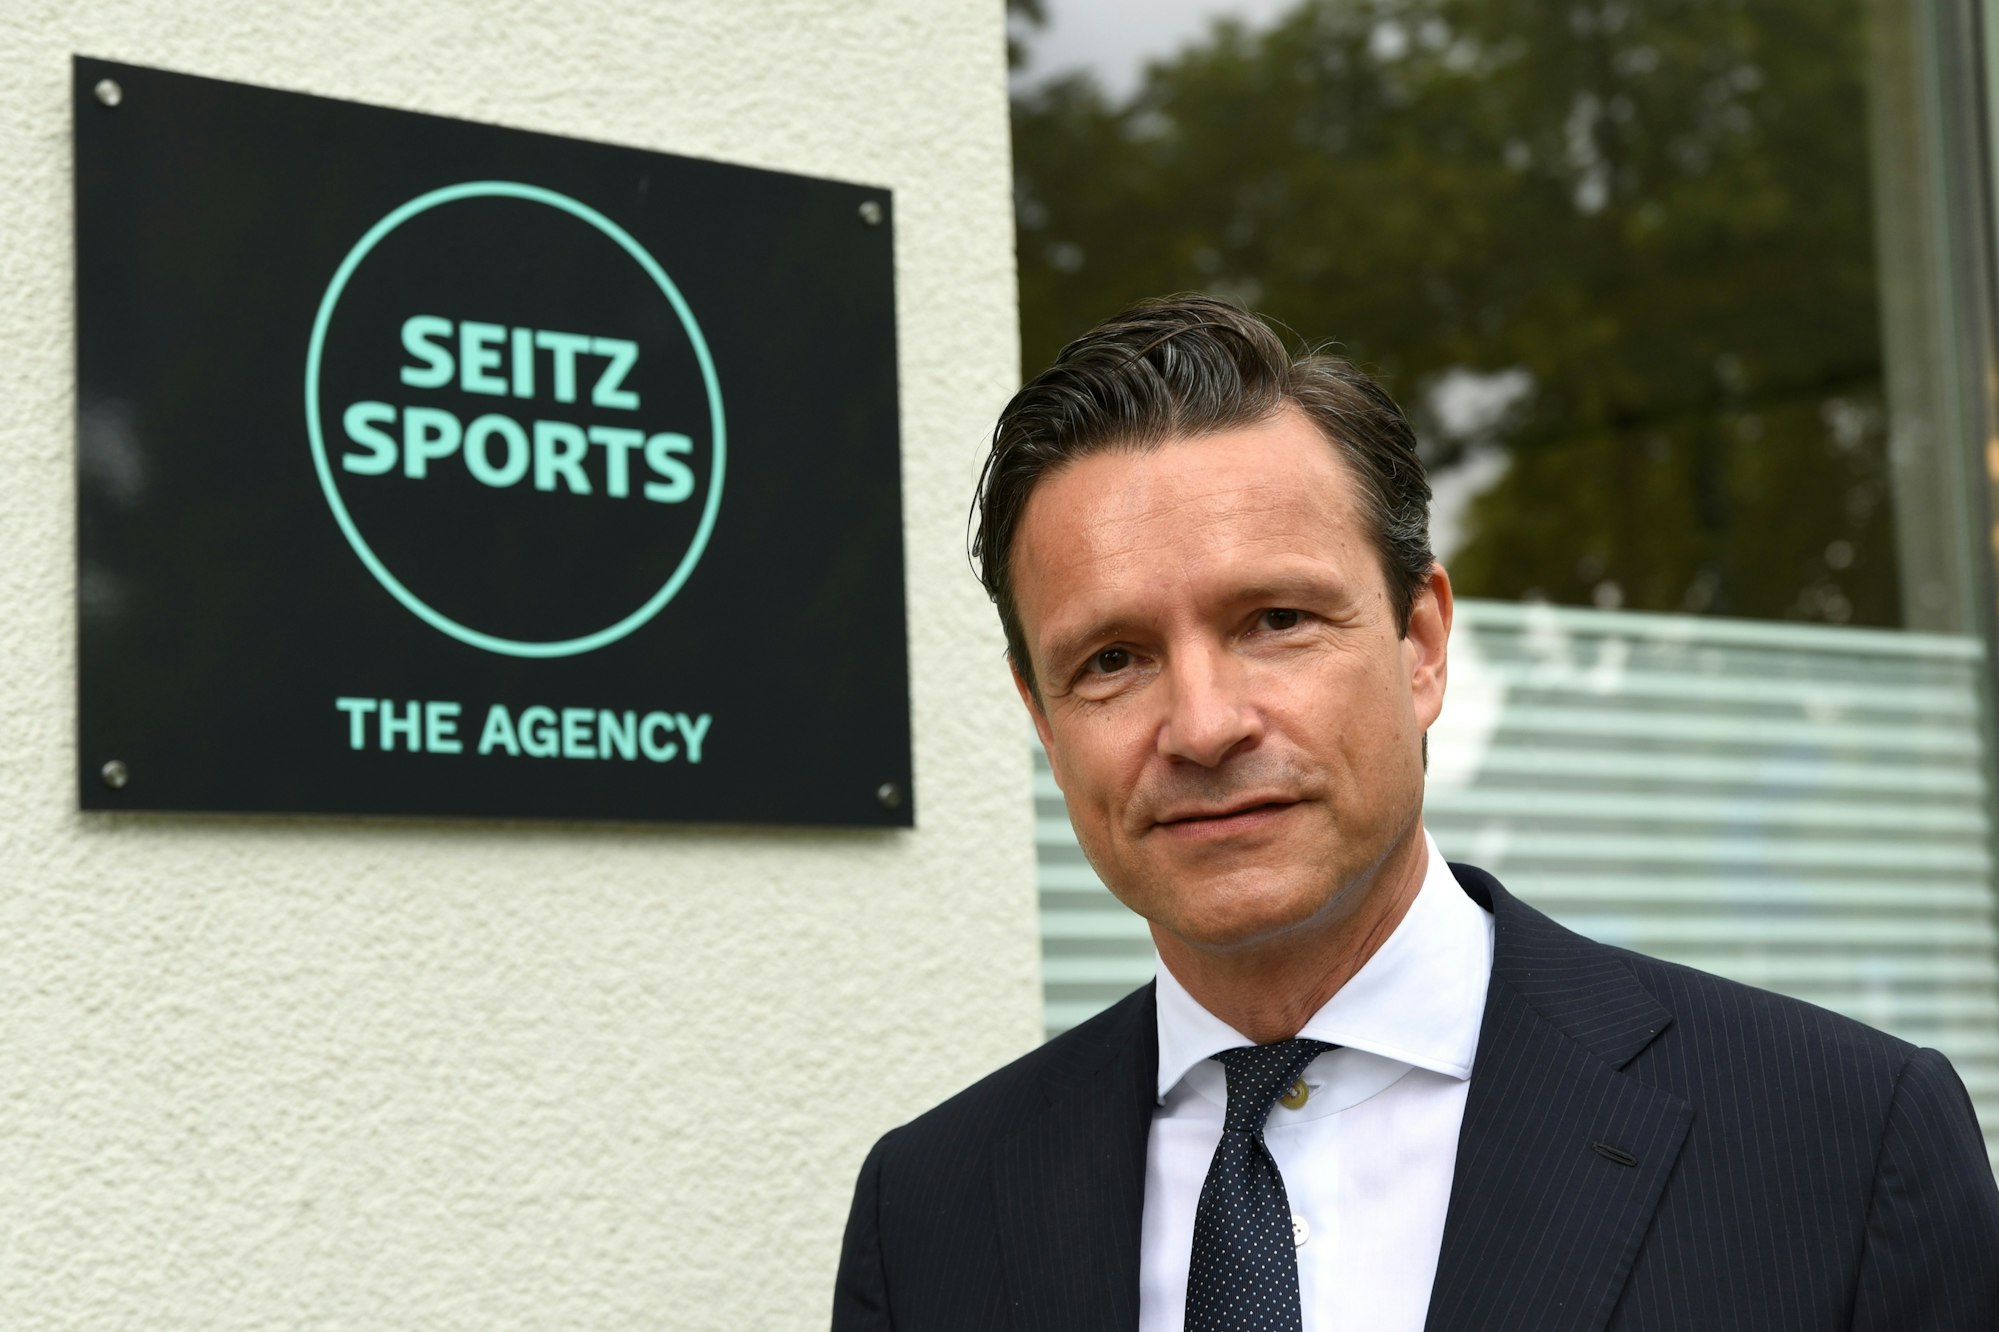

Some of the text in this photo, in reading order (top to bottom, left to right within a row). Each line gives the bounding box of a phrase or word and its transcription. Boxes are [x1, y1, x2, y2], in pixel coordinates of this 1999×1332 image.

[400, 315, 640, 410] SEITZ
[342, 401, 695, 503] SPORTS
[335, 697, 712, 763] THE AGENCY
